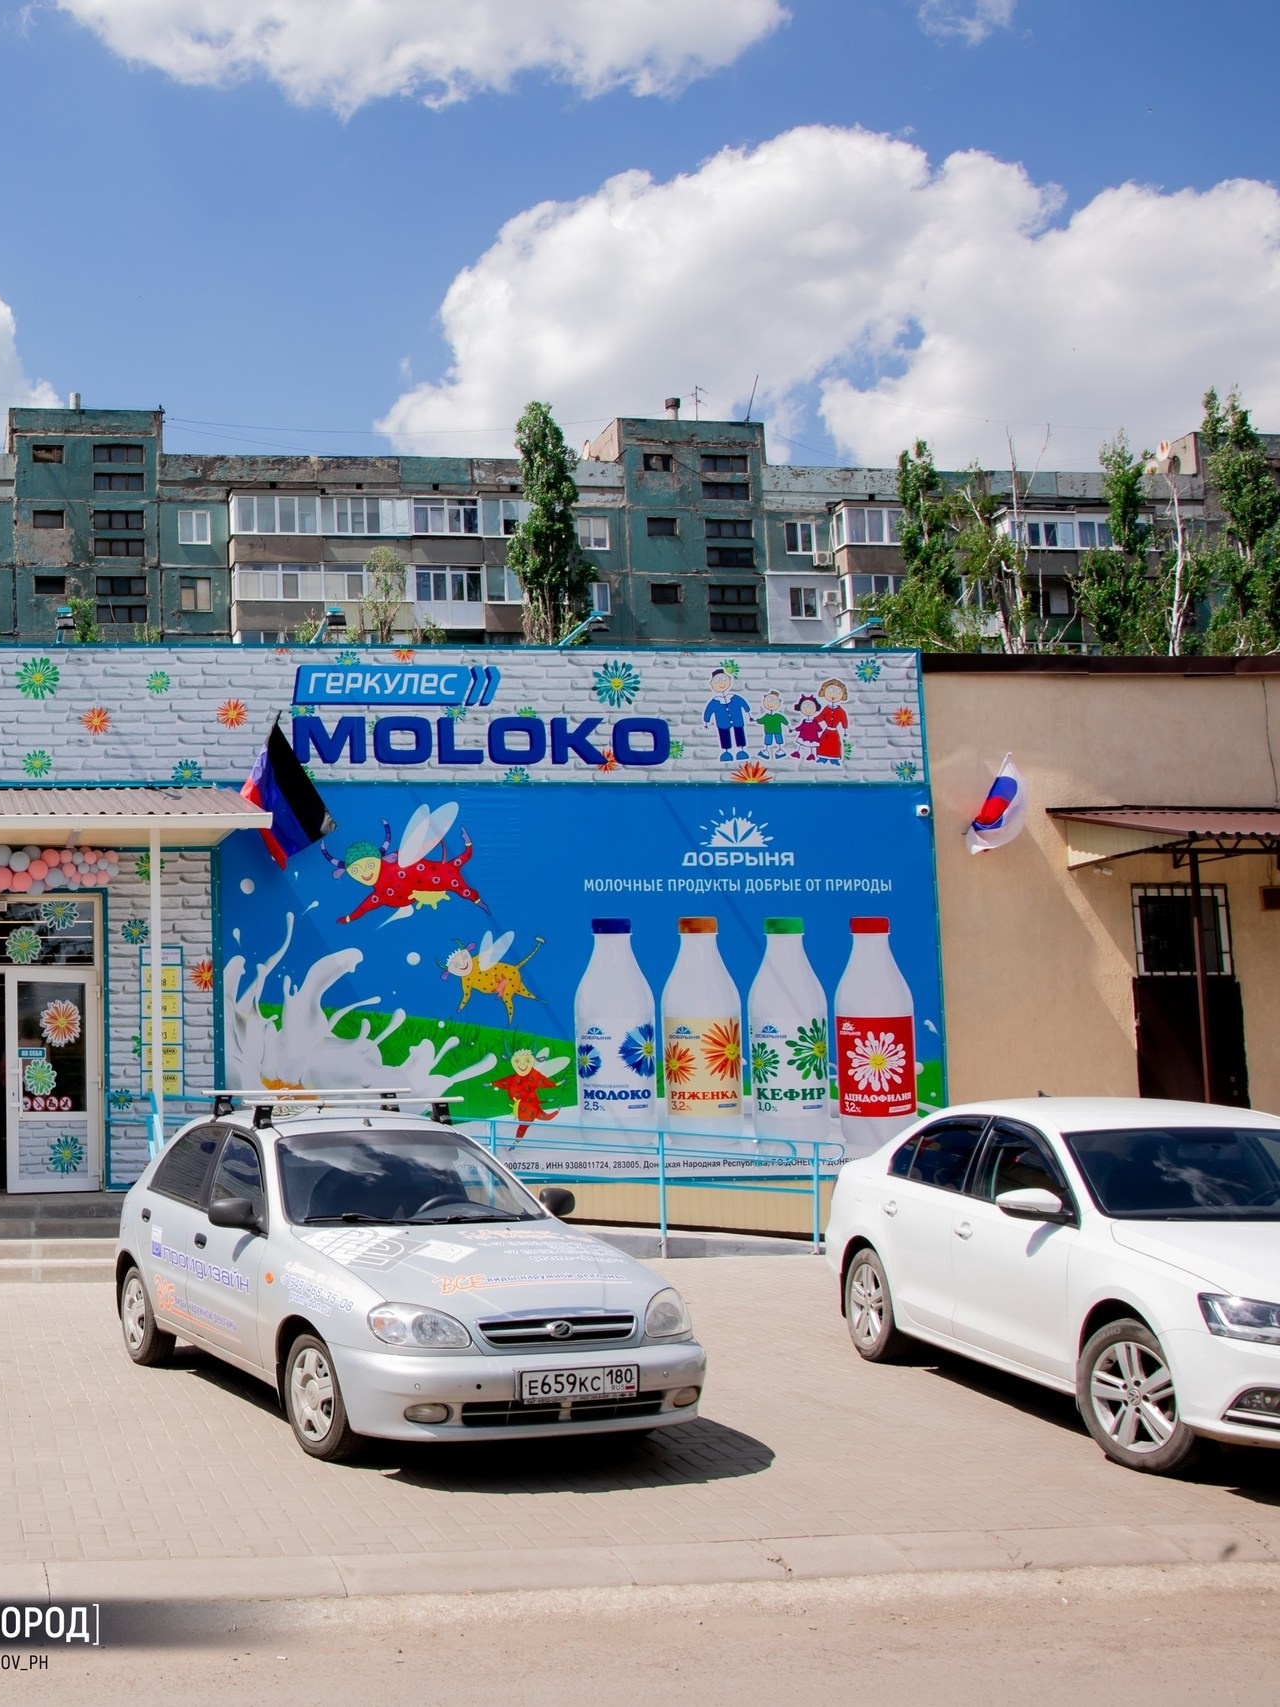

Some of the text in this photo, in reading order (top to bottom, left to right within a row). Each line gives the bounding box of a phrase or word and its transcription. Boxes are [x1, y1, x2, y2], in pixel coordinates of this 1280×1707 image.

[307, 671, 458, 697] ГЕРКУЛЕС
[293, 715, 669, 766] MOLOKO
[681, 851, 795, 868] ДОБРЫНЯ
[583, 877, 893, 895] МОЛОЧНЫЕ ПРОДУКТЫ ДОБРЫЕ ОТ ПРИРОДЫ
[583, 1089, 652, 1101] МОЛОКО
[670, 1090, 738, 1101] РЯЖЕНКА
[756, 1088, 826, 1101] КЕФИР
[583, 1101, 606, 1112] 2,5%
[671, 1101, 692, 1111] 3,2%
[757, 1101, 778, 1112] 1,0%
[844, 1101, 862, 1113] 3,2%
[546, 1162, 564, 1170] ИНН
[565, 1161, 611, 1170] 9308011724,
[612, 1160, 642, 1170] 283005,
[643, 1160, 680, 1170] Донцкая
[682, 1160, 721, 1169] Народная
[162, 1244, 251, 1296] промдизайн
[432, 1274, 487, 1296] ВСЕ
[306, 1283, 354, 1313] 468-35-08
[528, 1368, 633, 1396] Е659КС 180
